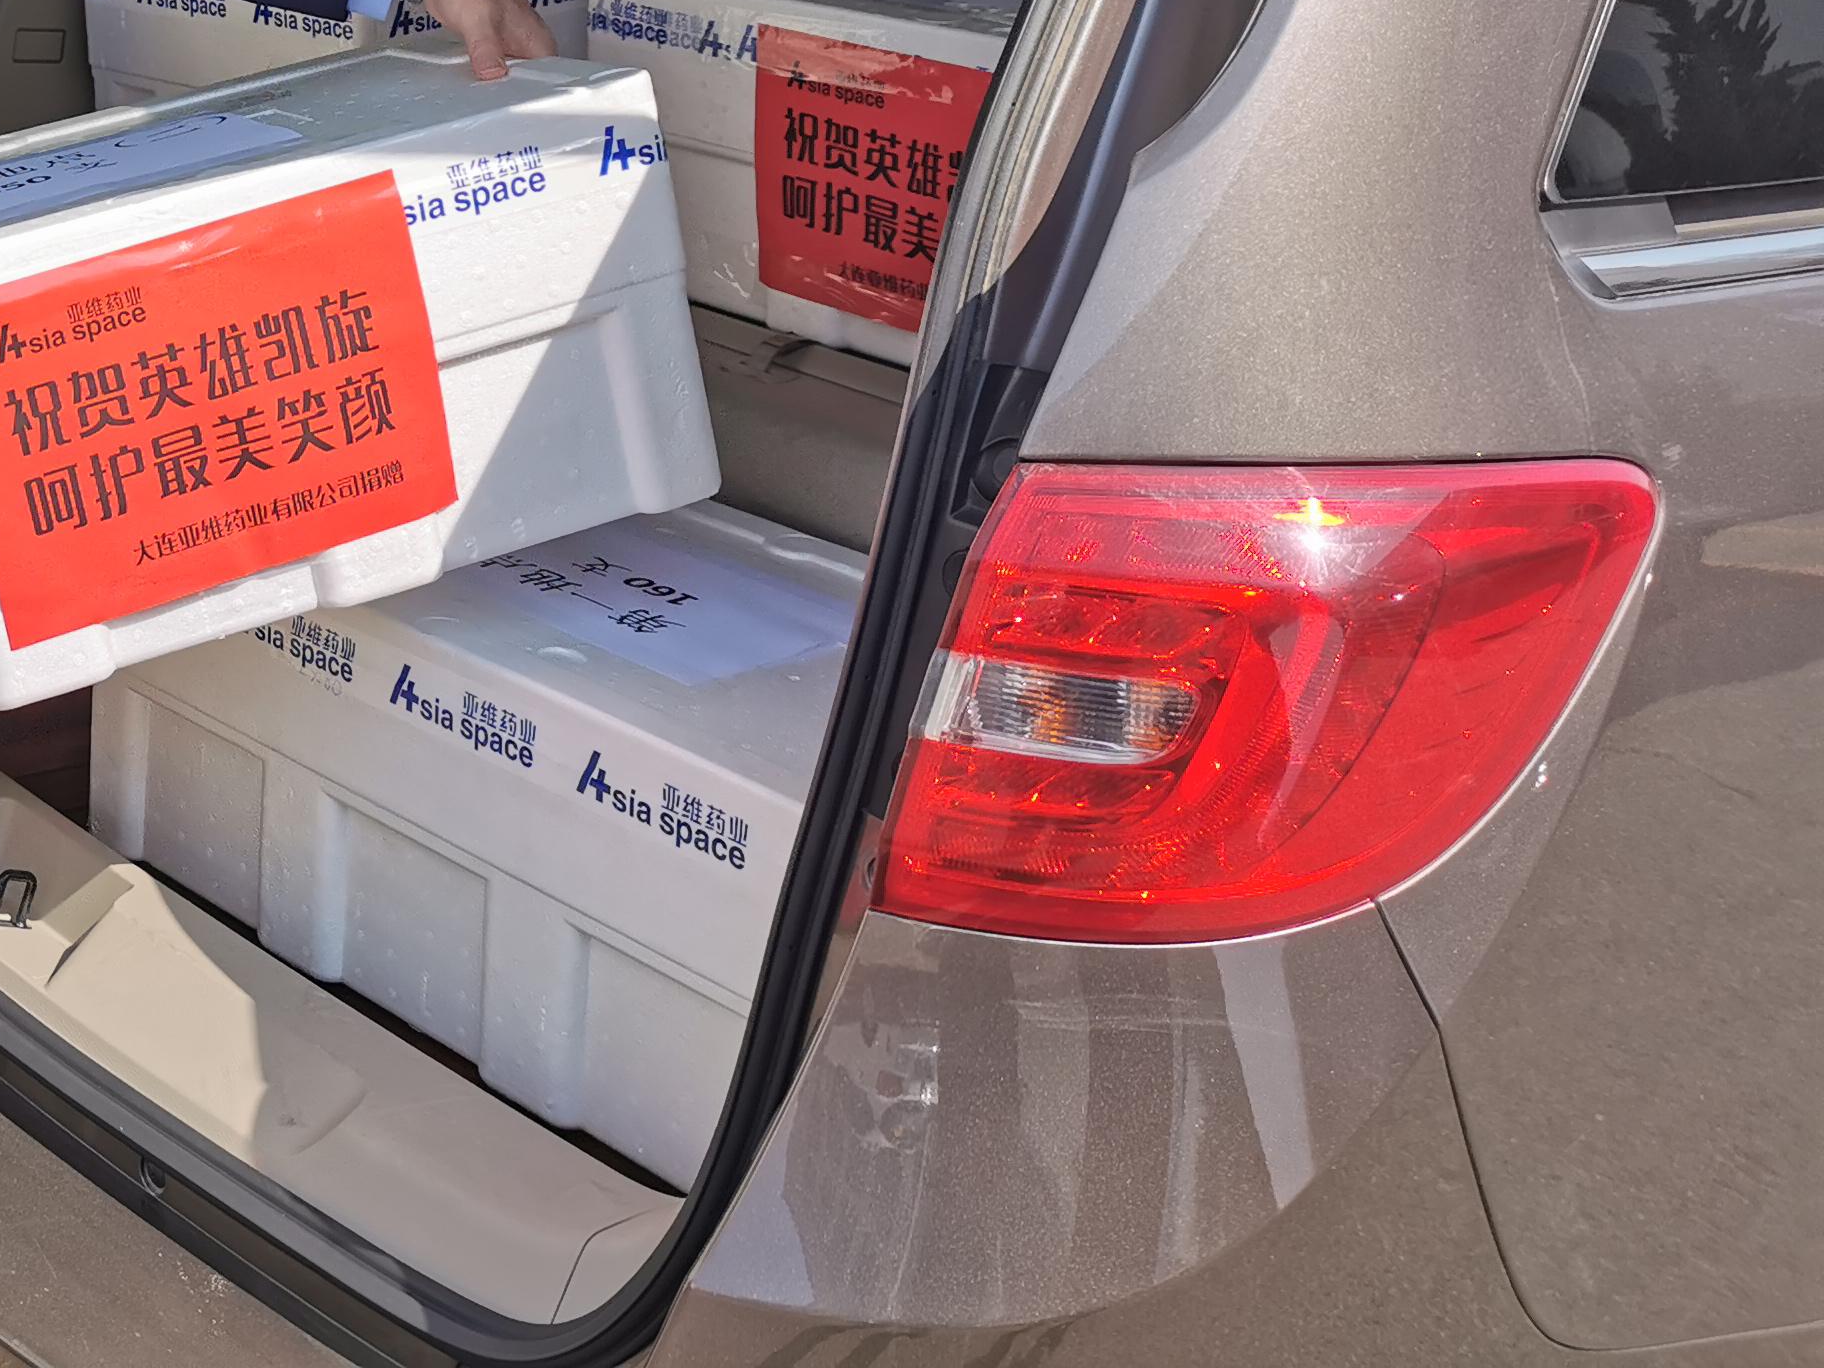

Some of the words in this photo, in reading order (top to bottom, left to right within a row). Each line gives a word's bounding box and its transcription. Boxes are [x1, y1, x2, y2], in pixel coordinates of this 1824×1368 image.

[253, 2, 298, 31] Asia
[302, 12, 354, 41] space
[835, 85, 886, 110] space
[403, 194, 446, 226] sia
[454, 170, 547, 215] space
[782, 174, 940, 264] 呵护最美
[66, 285, 142, 325] 亚维药业
[71, 306, 147, 342] space
[4, 288, 381, 457] 祝贺英雄凯旋
[23, 366, 397, 537] 呵护最美笑颜
[132, 459, 406, 567] 大连亚维药业有限公司捐赠
[253, 623, 285, 651] sia
[288, 637, 354, 683] space
[292, 614, 357, 663] 亚维药业
[389, 663, 454, 732] Asia
[459, 714, 535, 769] space
[462, 690, 537, 747] 亚维药业
[576, 749, 652, 826] Asia
[658, 810, 747, 870] space
[662, 782, 749, 858] 亚维药业
